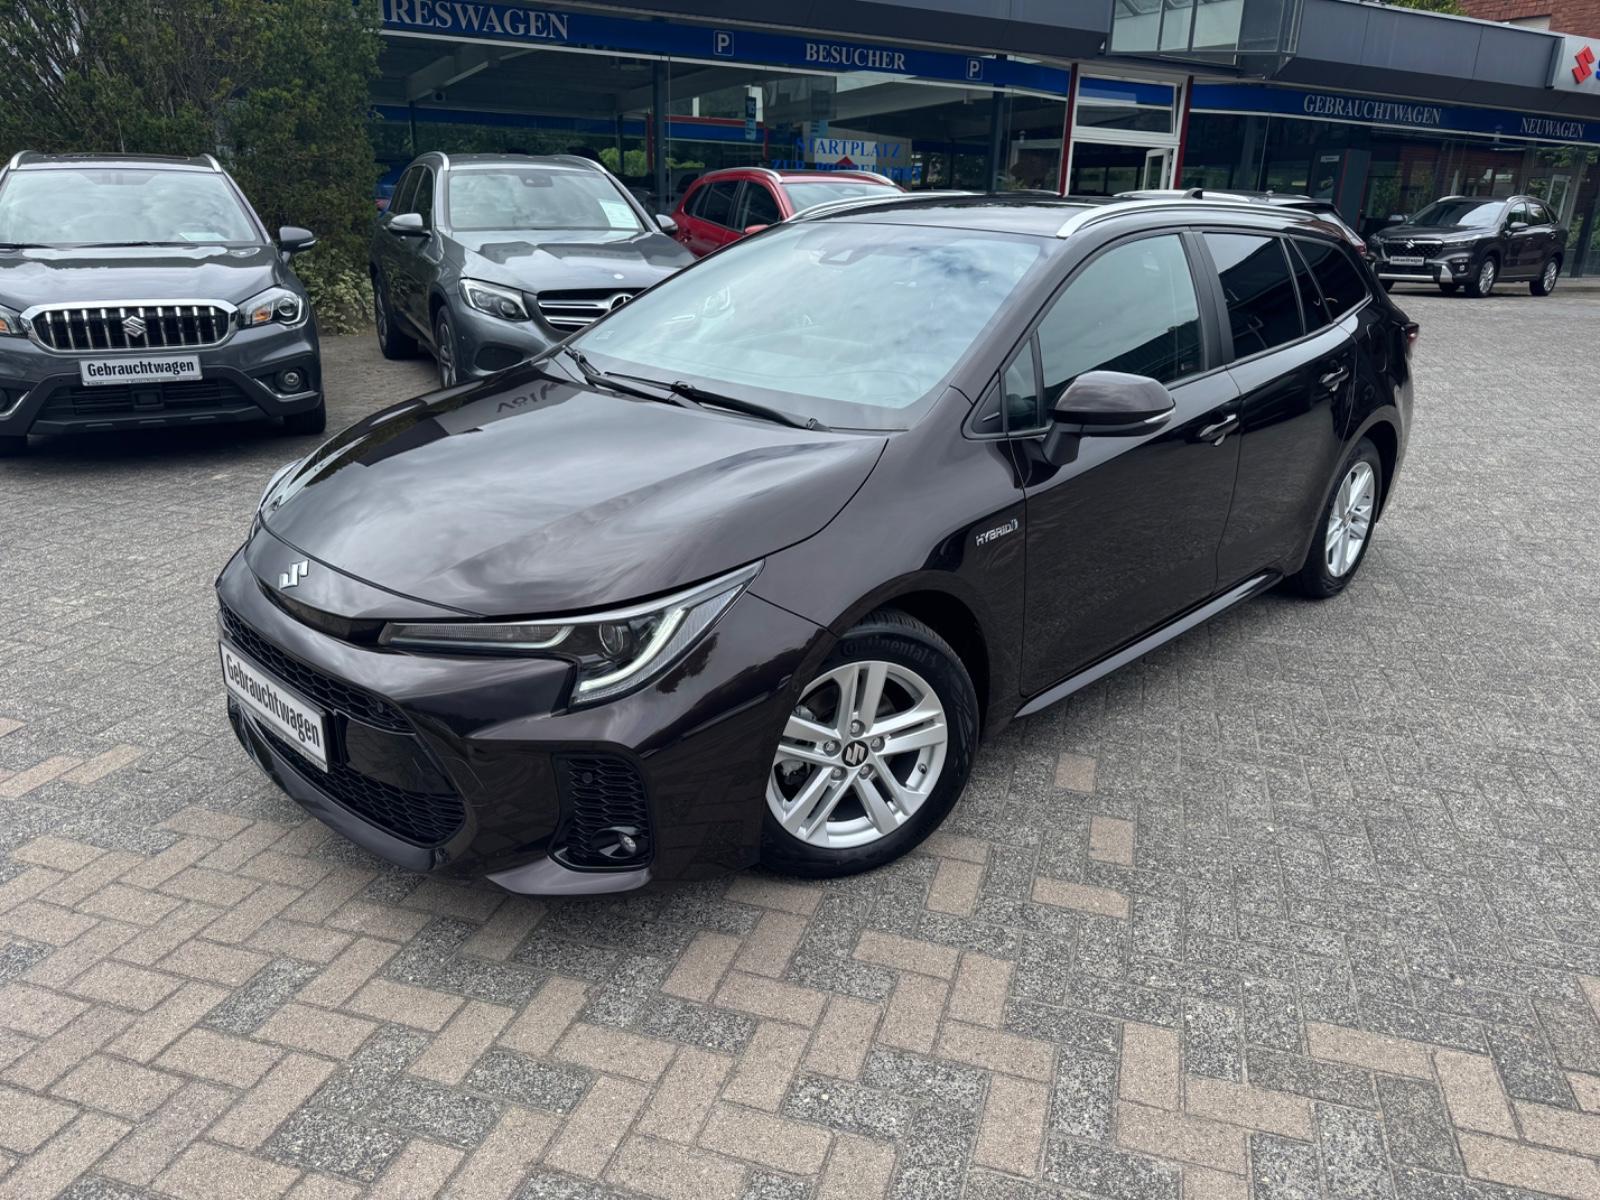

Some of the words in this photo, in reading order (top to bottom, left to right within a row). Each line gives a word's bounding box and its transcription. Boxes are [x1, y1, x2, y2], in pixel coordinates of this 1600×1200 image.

[379, 0, 568, 39] RESWAGEN
[805, 43, 906, 70] BESUCHER
[1303, 94, 1442, 124] GEBRAUCHTWAGEN
[1520, 117, 1585, 138] NEUWAGEN
[795, 137, 900, 158] STARTPLATZ
[87, 361, 195, 377] Gebrauchtwagen
[976, 521, 1014, 547] HYBRID
[226, 654, 320, 748] Gebrauchtwagen
